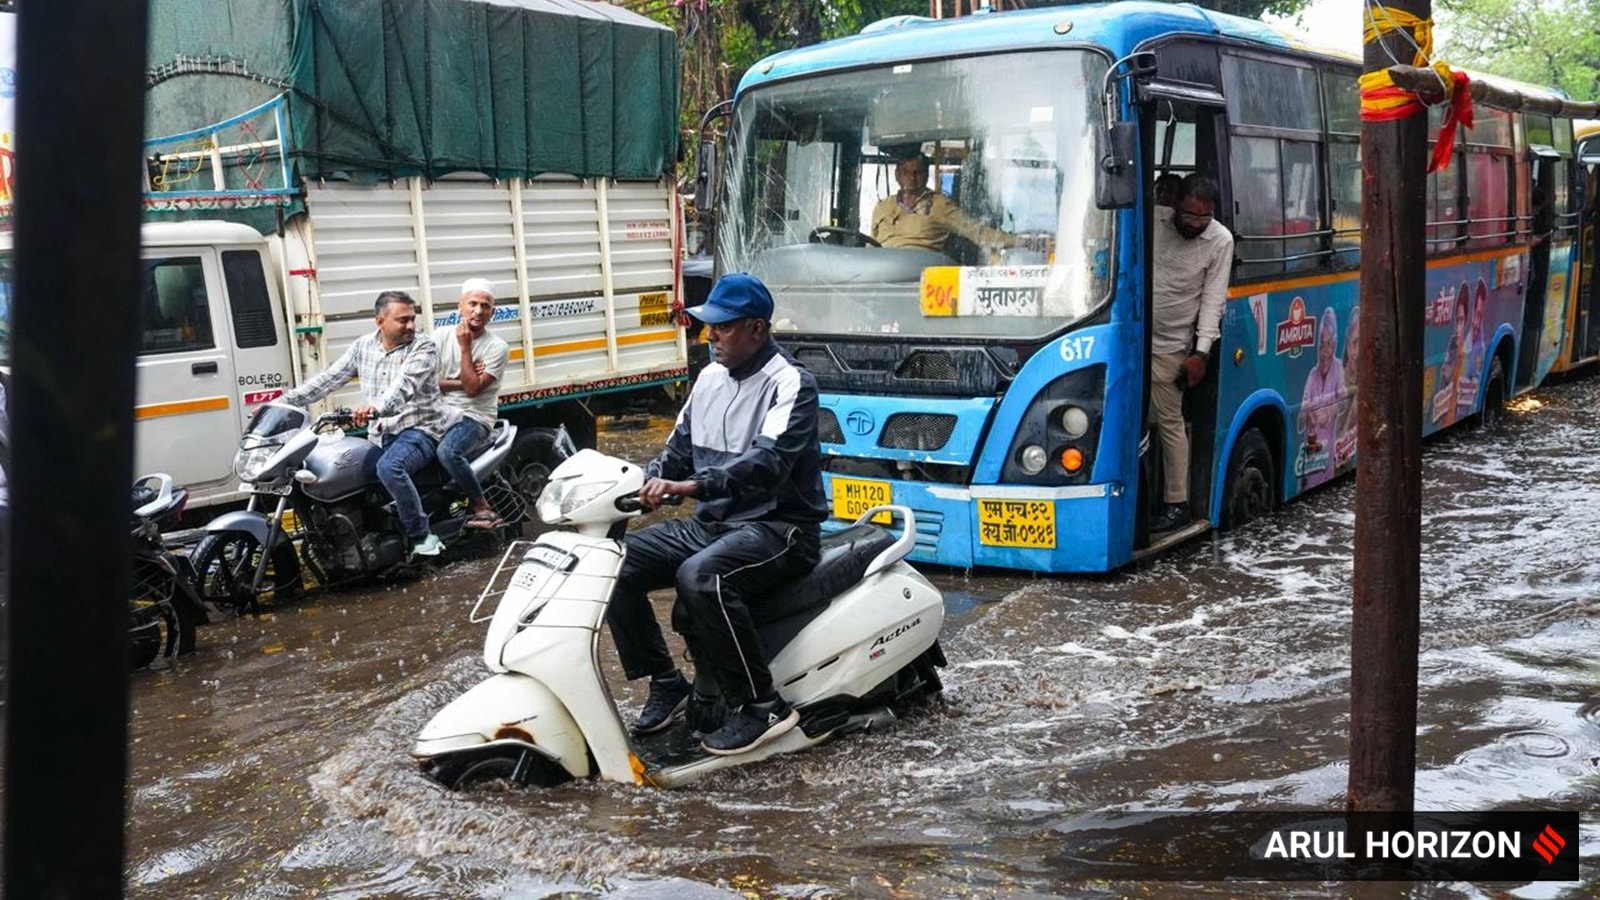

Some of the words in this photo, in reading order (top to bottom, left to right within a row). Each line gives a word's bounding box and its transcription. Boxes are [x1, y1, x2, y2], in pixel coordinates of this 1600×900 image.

[1279, 323, 1313, 344] AMRUTA
[1061, 336, 1095, 361] 617
[238, 373, 282, 385] BOLERO
[982, 501, 1003, 519] एम
[870, 618, 921, 650] Activa
